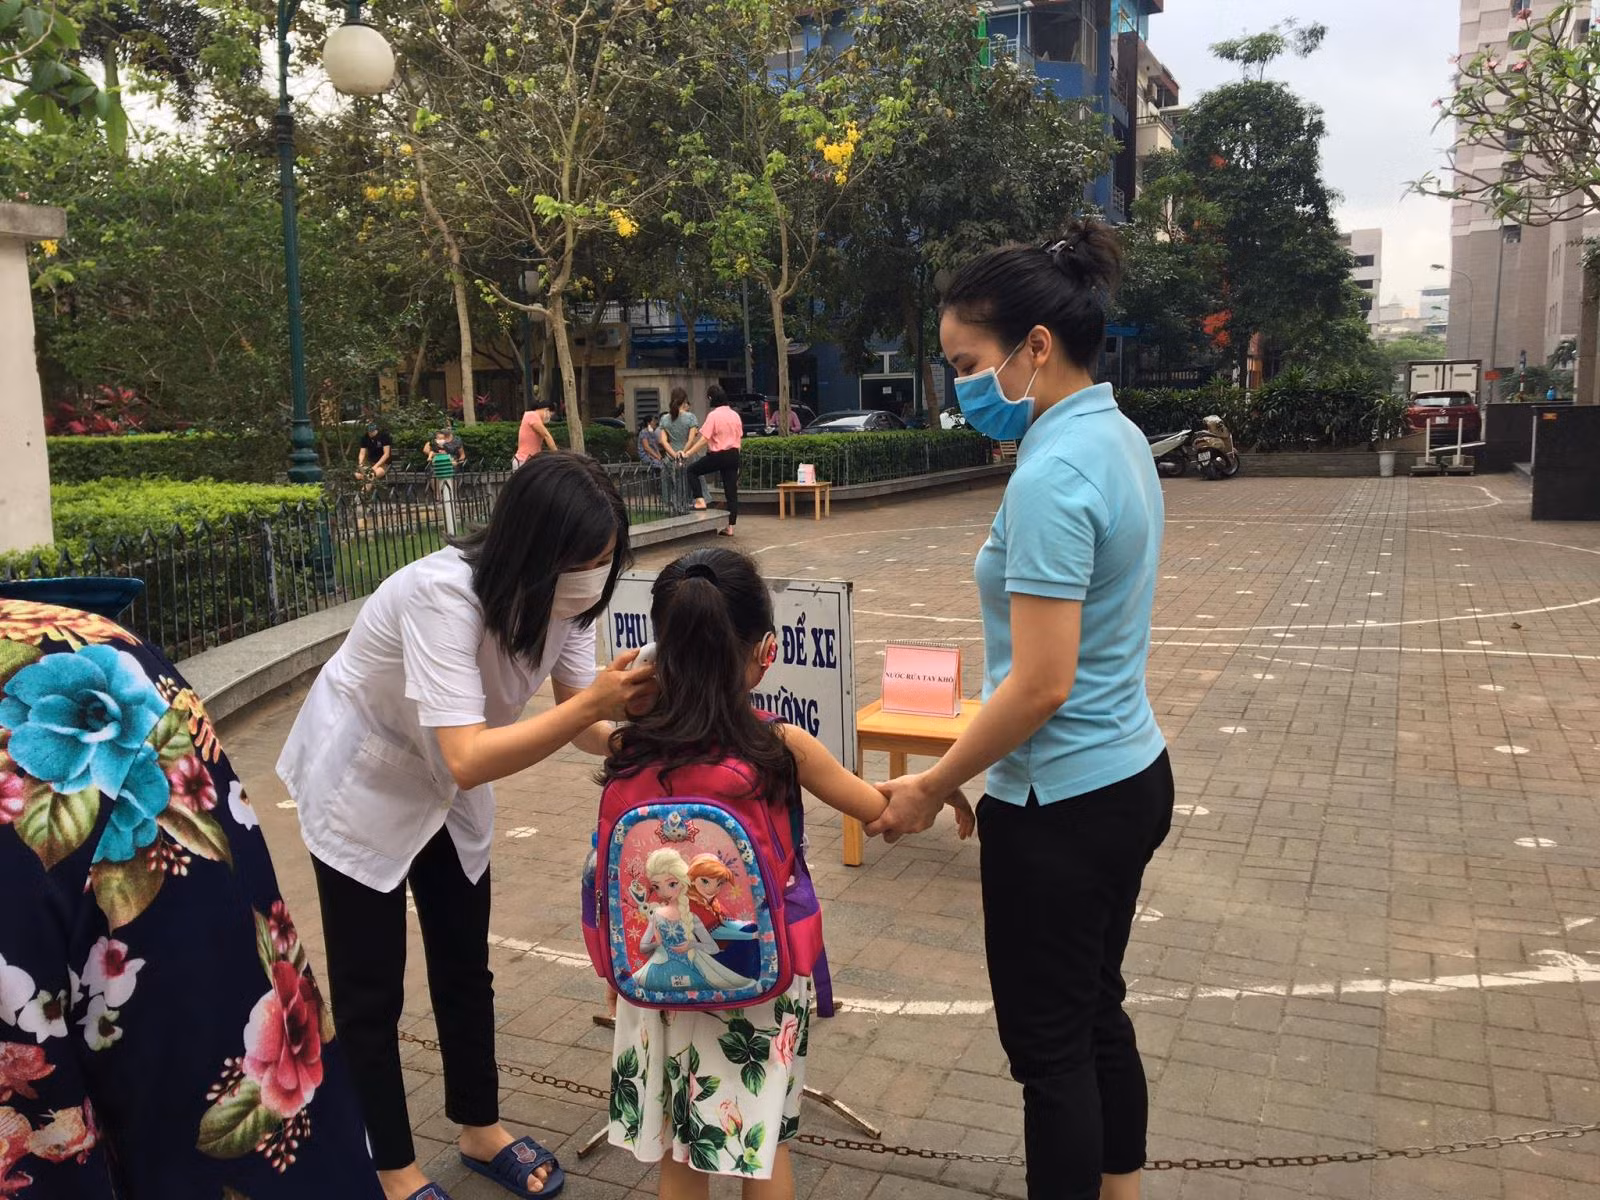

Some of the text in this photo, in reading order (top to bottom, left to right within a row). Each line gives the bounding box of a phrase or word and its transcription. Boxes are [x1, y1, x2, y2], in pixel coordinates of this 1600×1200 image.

[782, 611, 807, 666] ĐỂ
[811, 627, 837, 669] XE
[923, 674, 936, 682] TAY
